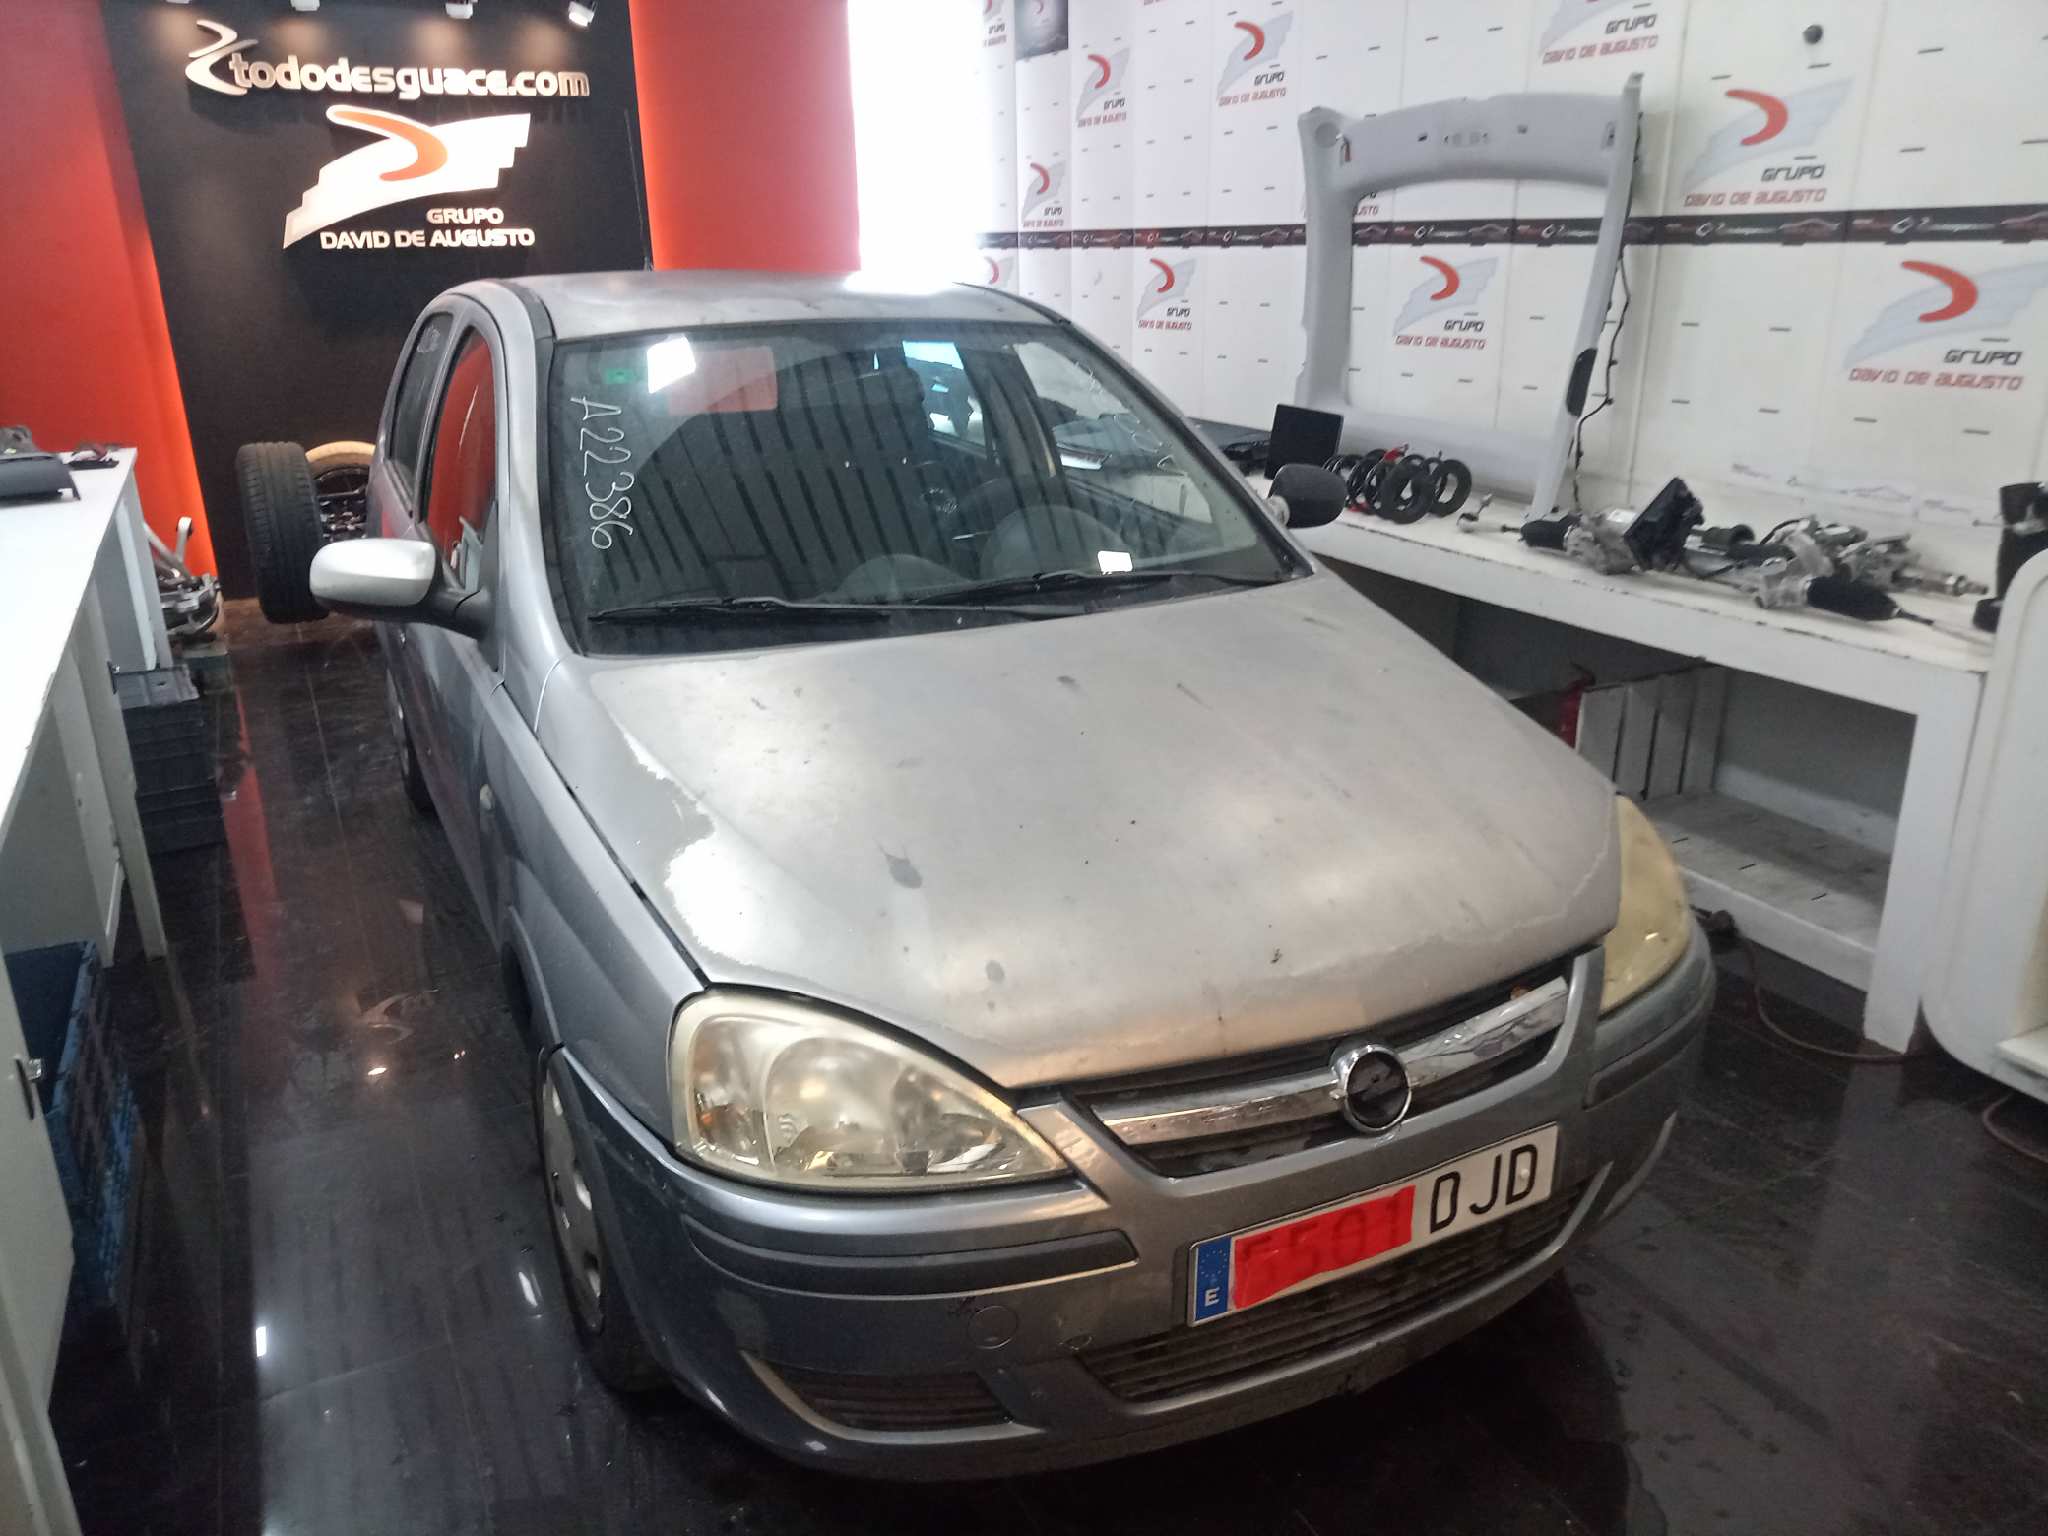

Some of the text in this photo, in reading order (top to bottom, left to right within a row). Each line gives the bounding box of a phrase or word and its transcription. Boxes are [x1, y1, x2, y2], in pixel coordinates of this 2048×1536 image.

[1605, 14, 1658, 34] GRUPO
[228, 52, 590, 100] tododesguace.com
[1760, 165, 1826, 182] GRUPO
[1753, 188, 1826, 205] AUGUSTO
[426, 207, 504, 225] GRUPO
[320, 227, 535, 249] DAVID DE AUGUSTO
[1944, 349, 2023, 366] GRUPO
[1934, 372, 2024, 391] AUGUSTO
[570, 396, 635, 549] A22386
[1430, 1144, 1538, 1234] DJD
[1204, 1287, 1220, 1307] E
